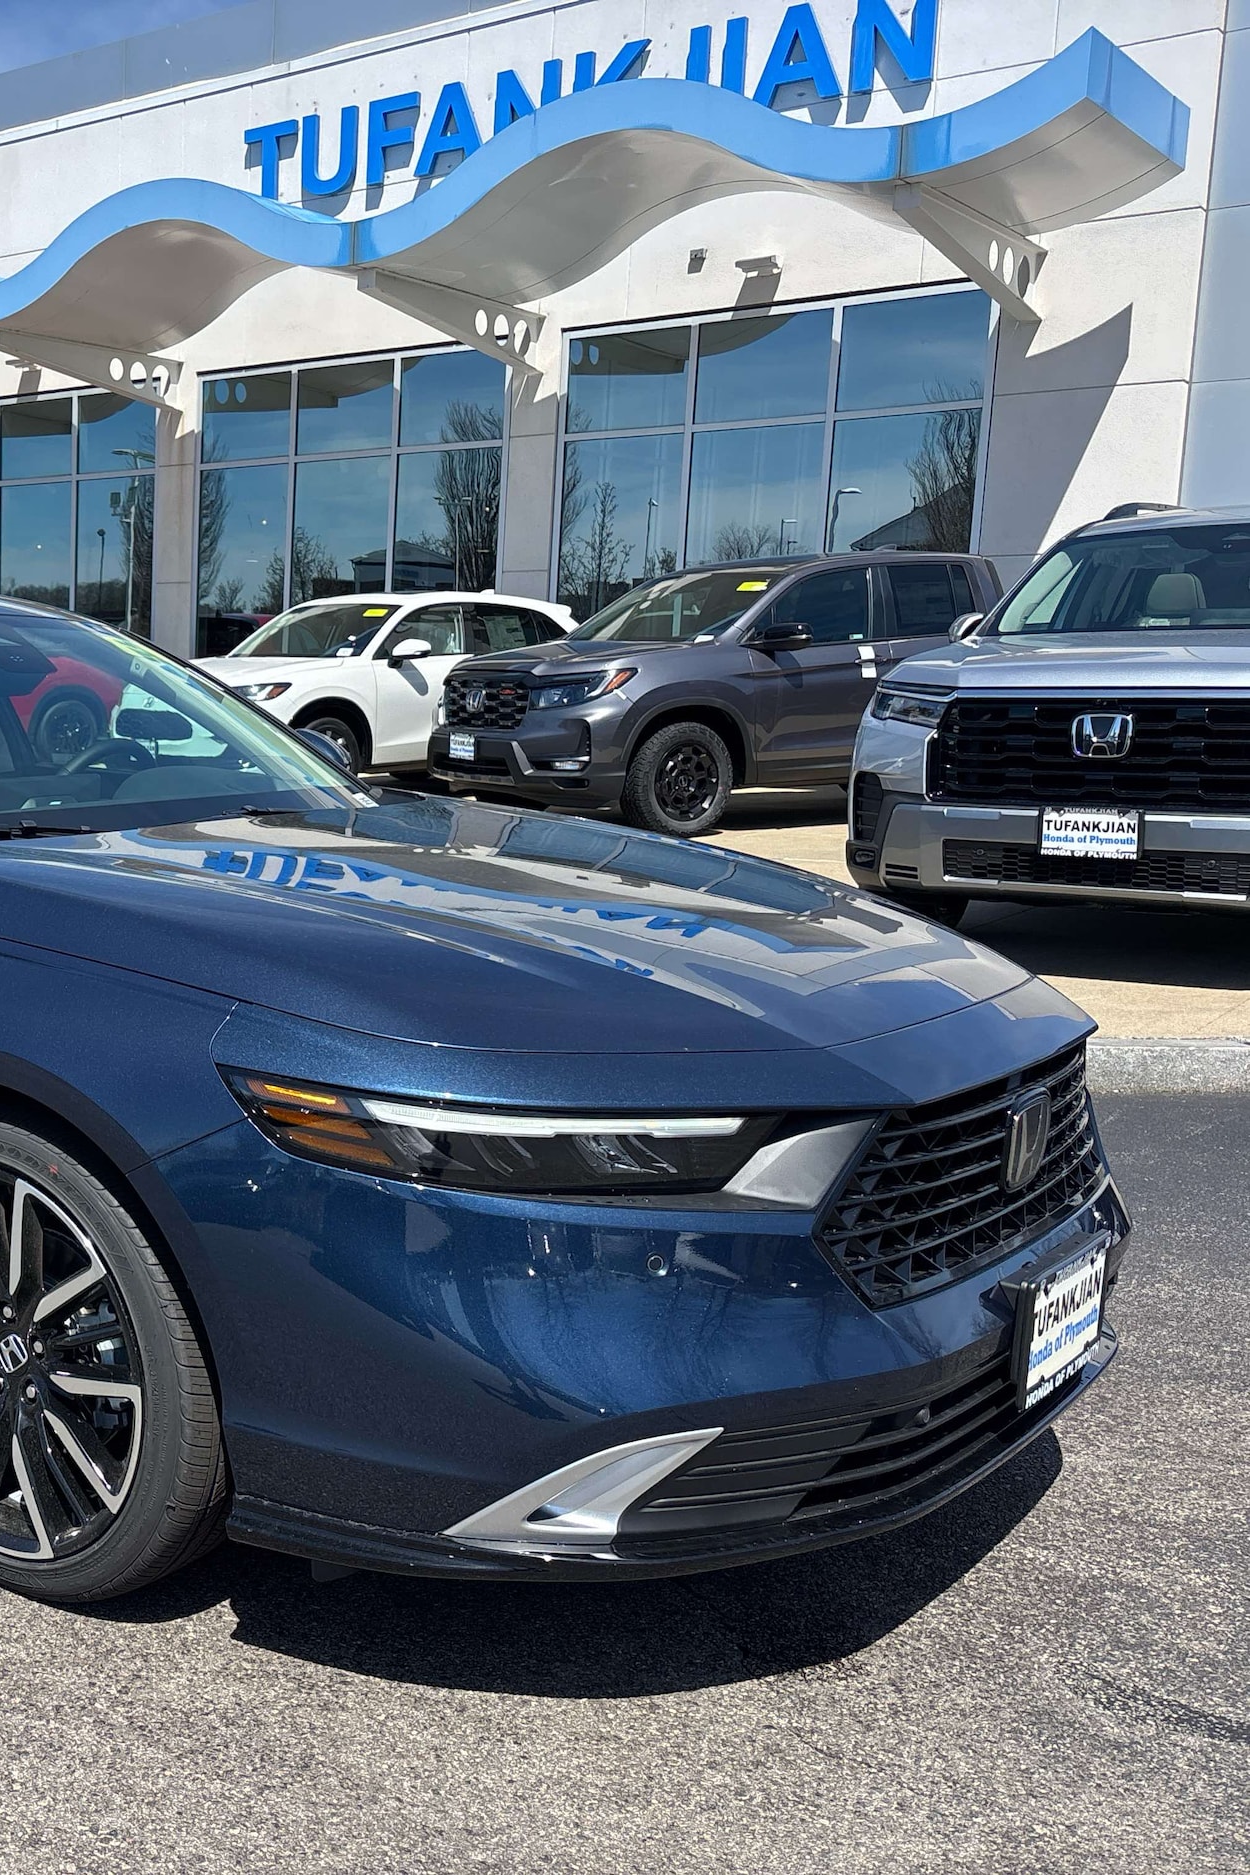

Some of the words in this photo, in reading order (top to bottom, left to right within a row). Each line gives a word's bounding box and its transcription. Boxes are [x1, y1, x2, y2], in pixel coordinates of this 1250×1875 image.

[1044, 819, 1137, 834] TUFANKJIAN
[1042, 833, 1074, 843] Honda
[1077, 835, 1087, 843] of
[1089, 835, 1136, 846] Plymouth
[1040, 848, 1071, 856] HONDA
[1087, 850, 1137, 860] PLYMOUTH
[1054, 1327, 1064, 1353] of
[1064, 1303, 1098, 1346] Plymouth
[1025, 1378, 1054, 1410] HONDA
[1055, 1368, 1066, 1388] OF
